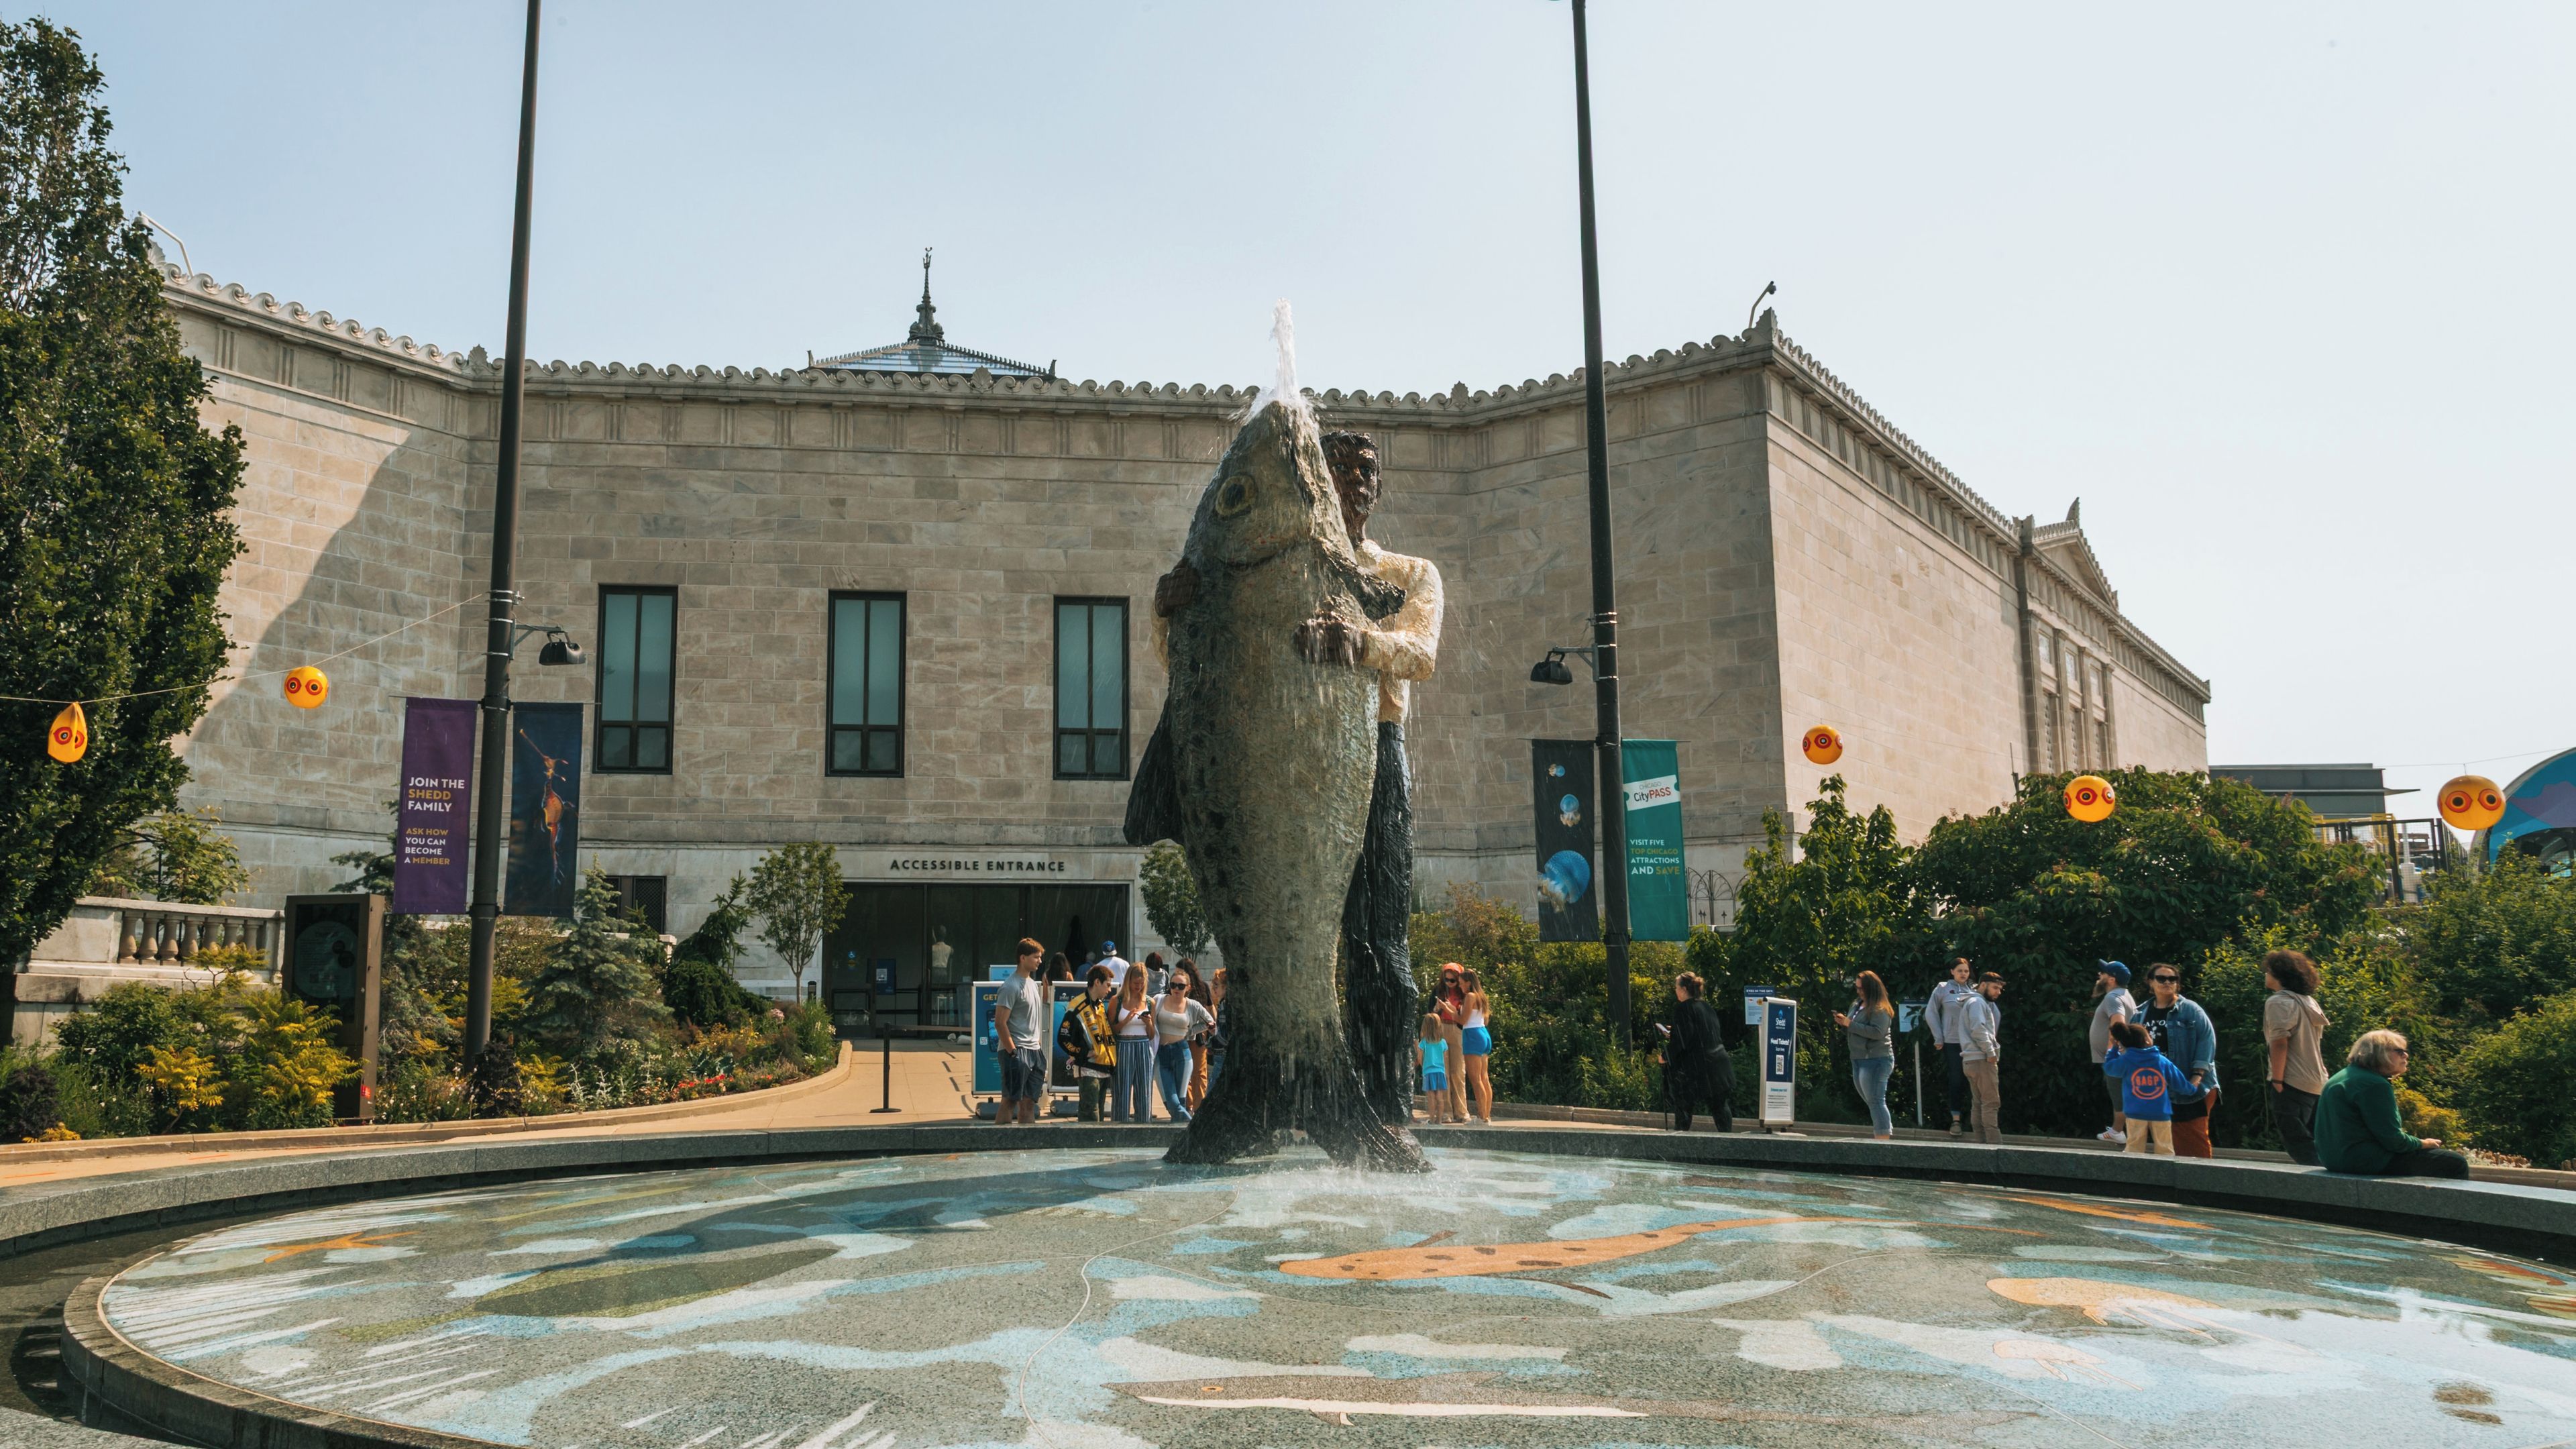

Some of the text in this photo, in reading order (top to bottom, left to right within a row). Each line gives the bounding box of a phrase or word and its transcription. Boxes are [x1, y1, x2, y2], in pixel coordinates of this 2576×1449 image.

[409, 777, 465, 789] JOIN THE
[1639, 781, 1662, 790] CHICAGO
[409, 789, 451, 800] SHEDD
[1633, 787, 1671, 803] CityPASS
[408, 801, 452, 812] FAMILY
[426, 828, 448, 836] HOW
[413, 857, 450, 865] MEMBER
[890, 860, 1065, 871] ACCESSIBLE ENTRANCE
[1656, 867, 1680, 875] SAVE
